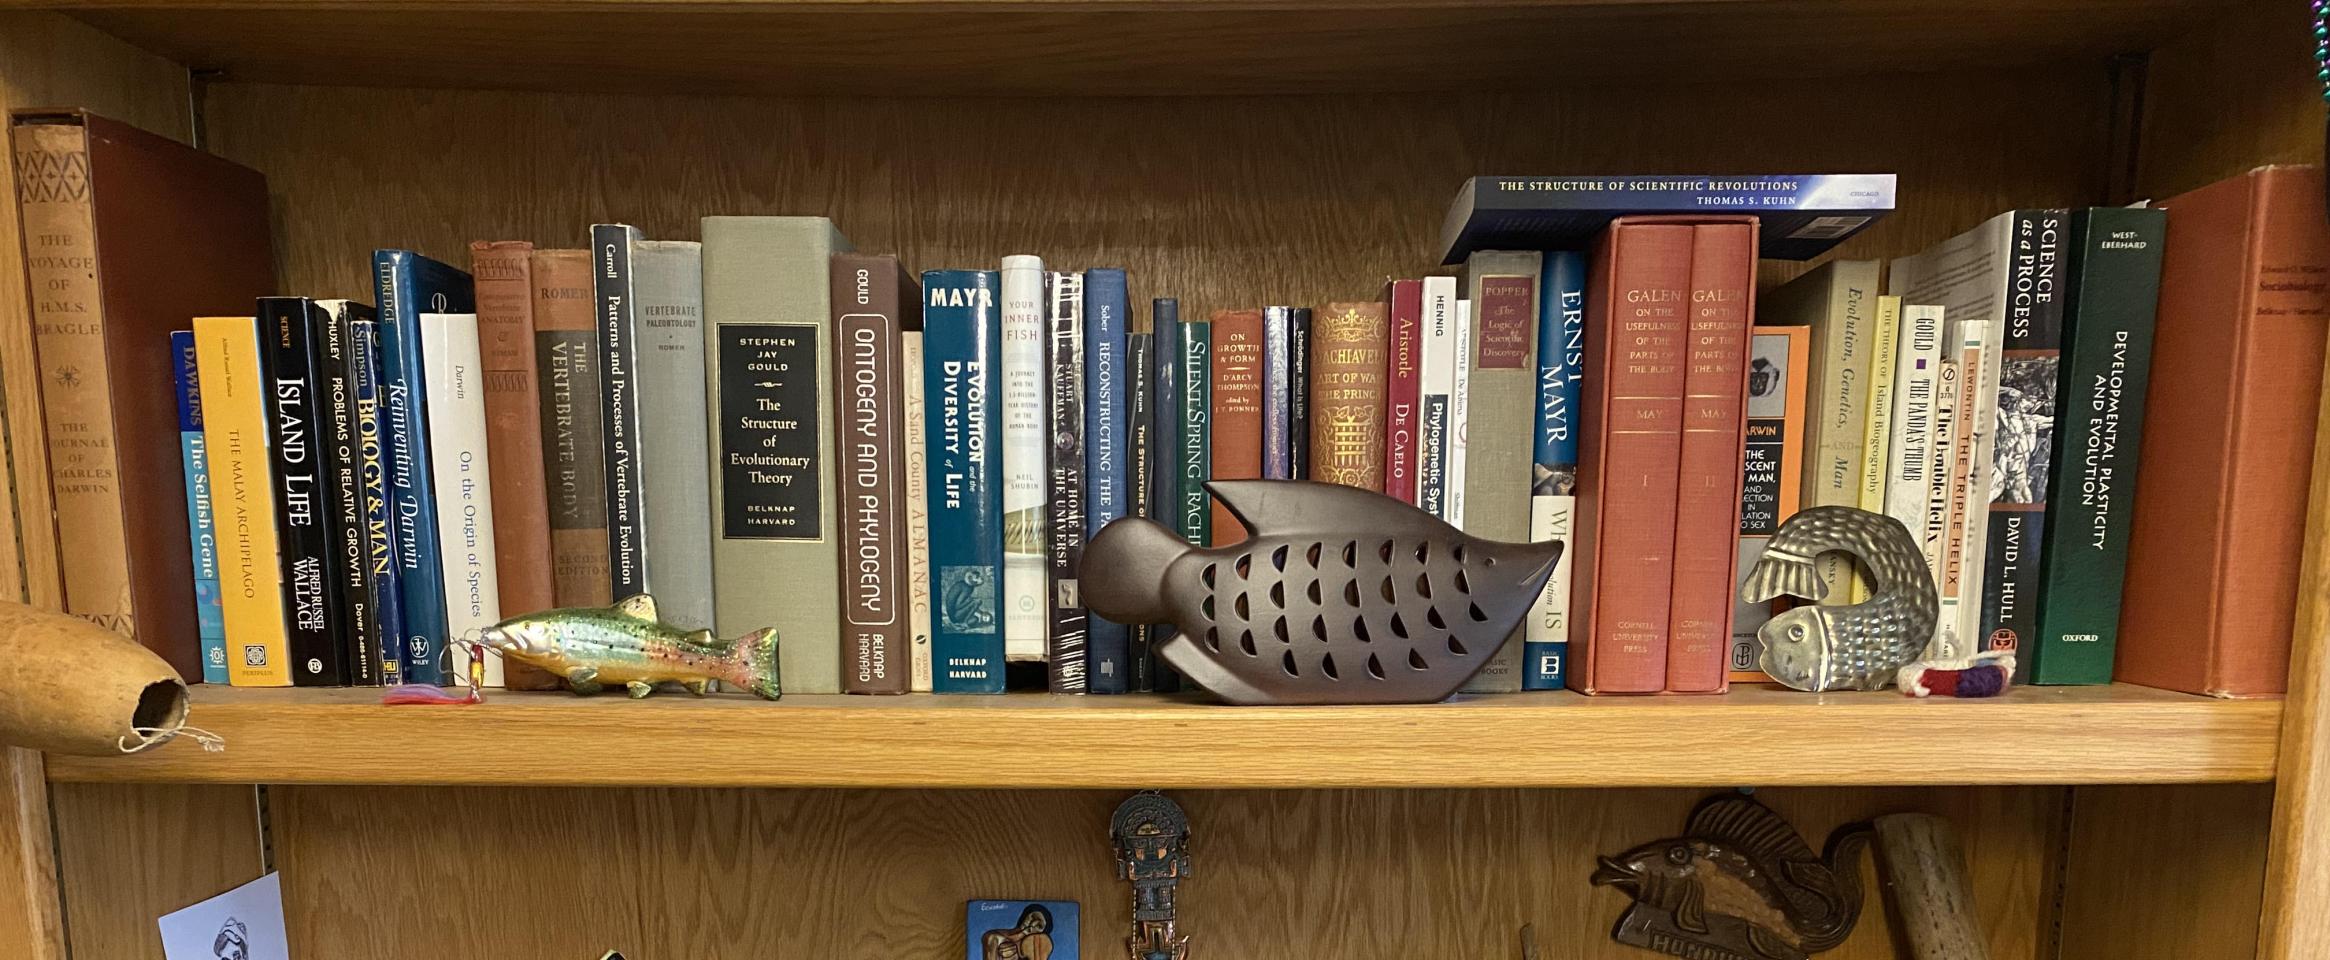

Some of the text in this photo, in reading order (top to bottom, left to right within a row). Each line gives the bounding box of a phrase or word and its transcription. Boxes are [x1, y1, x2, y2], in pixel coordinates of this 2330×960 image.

[1499, 181, 1798, 191] THE STRUCTURE OF SCIENTIFIC REVOLUTIONS
[1697, 196, 1796, 205] THOMAS S. KUHN
[40, 235, 72, 246] THE
[2112, 231, 2138, 239] WEST-
[2101, 241, 2147, 249] EBERHARD
[30, 257, 94, 269] VOYAGE
[2036, 219, 2058, 304] SCIENCE
[49, 280, 69, 290] OF
[2013, 219, 2035, 338] as a PROCESS
[856, 268, 869, 305] GOULD
[1485, 286, 1529, 297] POPPER
[379, 262, 396, 325] ELDREDGE
[541, 288, 589, 300] ROMER
[930, 287, 993, 308] MAYR
[1627, 289, 1682, 302] GALEN
[41, 302, 87, 313] H.M.S.
[645, 305, 696, 317] VERTEBRATE
[1009, 301, 1034, 309] YOUR
[1636, 308, 1674, 317] ON THE
[1884, 310, 1893, 328] THE
[646, 319, 697, 328] PALEONTOLOGY
[1005, 315, 1040, 324] INNER
[1488, 319, 1524, 331] Logic of
[1007, 330, 1037, 341] FISH
[1230, 333, 1245, 342] ON
[1561, 289, 1583, 384] ERNST
[1636, 337, 1671, 345] OF THE
[739, 338, 796, 347] STEPHEN
[1217, 344, 1260, 353] GROWTH
[1880, 329, 1892, 364] THEORY
[353, 325, 368, 387] Simpson
[573, 342, 588, 373] THE
[1483, 348, 1526, 360] Discovery
[747, 363, 789, 372] GOULD
[455, 365, 465, 400] Darwin
[1065, 363, 1075, 403] STUART
[1223, 374, 1252, 382] D'ARCY
[183, 346, 201, 426] DAWKINS
[1217, 383, 1260, 391] THOMPSON
[1834, 286, 1863, 490] Evolution, Genetics, Man
[756, 398, 782, 411] The
[1393, 317, 1414, 479] Aristotle DE CAELO
[1877, 384, 1887, 417] Island
[1903, 318, 1935, 482] GOULD THE PANDA'S THUMB
[1541, 365, 1568, 445] MAYR
[606, 243, 635, 586] Carroll Patterns and Processes of Vertebrate Evolution
[1637, 409, 1663, 419] MAY
[60, 423, 88, 432] THE
[741, 416, 798, 430] Structure
[967, 361, 984, 492] EVOLUTION and the
[551, 341, 578, 519] VERTEBRATE BODY
[943, 361, 963, 509] DIVERSITY of LIFE
[762, 435, 777, 448] of
[2082, 374, 2108, 506] AND EVOLUTION
[2092, 331, 2128, 551] DEVELOPMENTAL PLASTICITY
[68, 454, 84, 463] OF
[276, 377, 313, 527] ISLAND LIFE
[1745, 449, 1765, 460] THE
[1866, 418, 1885, 495] Biogeography
[730, 453, 811, 470] Evolutionary
[389, 378, 423, 570] Reinventing Darwin
[854, 328, 881, 612] ONTOGENY AND PHYLOGENY
[1947, 361, 1976, 585] LEWONTIN THE TRIPLE HELIX
[748, 471, 793, 487] Theory
[1016, 473, 1034, 481] NEIL
[1748, 473, 1776, 484] MAN,
[57, 484, 109, 494] DARWIN
[358, 398, 390, 576] BIOLOGY & MAN
[1010, 482, 1040, 490] SHUBIN
[1744, 485, 1762, 494] AND
[190, 436, 214, 578] The Selfish Gene
[747, 505, 796, 513] BELKNAP
[1067, 469, 1079, 548] AT HOME IN
[1748, 503, 1756, 511] IN
[229, 429, 255, 599] THE MALAY ARCHIPELAGO
[1055, 469, 1068, 568] THE UNIVERSE
[747, 518, 796, 526] HARVARD
[1750, 520, 1766, 529] SEX
[459, 450, 482, 618] On the Origin of Species
[307, 556, 322, 595] ALFRED
[2000, 516, 2021, 624] DAVID L. HULL
[293, 559, 313, 631] WALLACE
[2062, 634, 2099, 642] OXFORD
[858, 633, 871, 683] HARVARD
[873, 633, 885, 679] BELKNAP
[949, 658, 987, 666] BELKNAP
[949, 671, 987, 679] HARVARD
